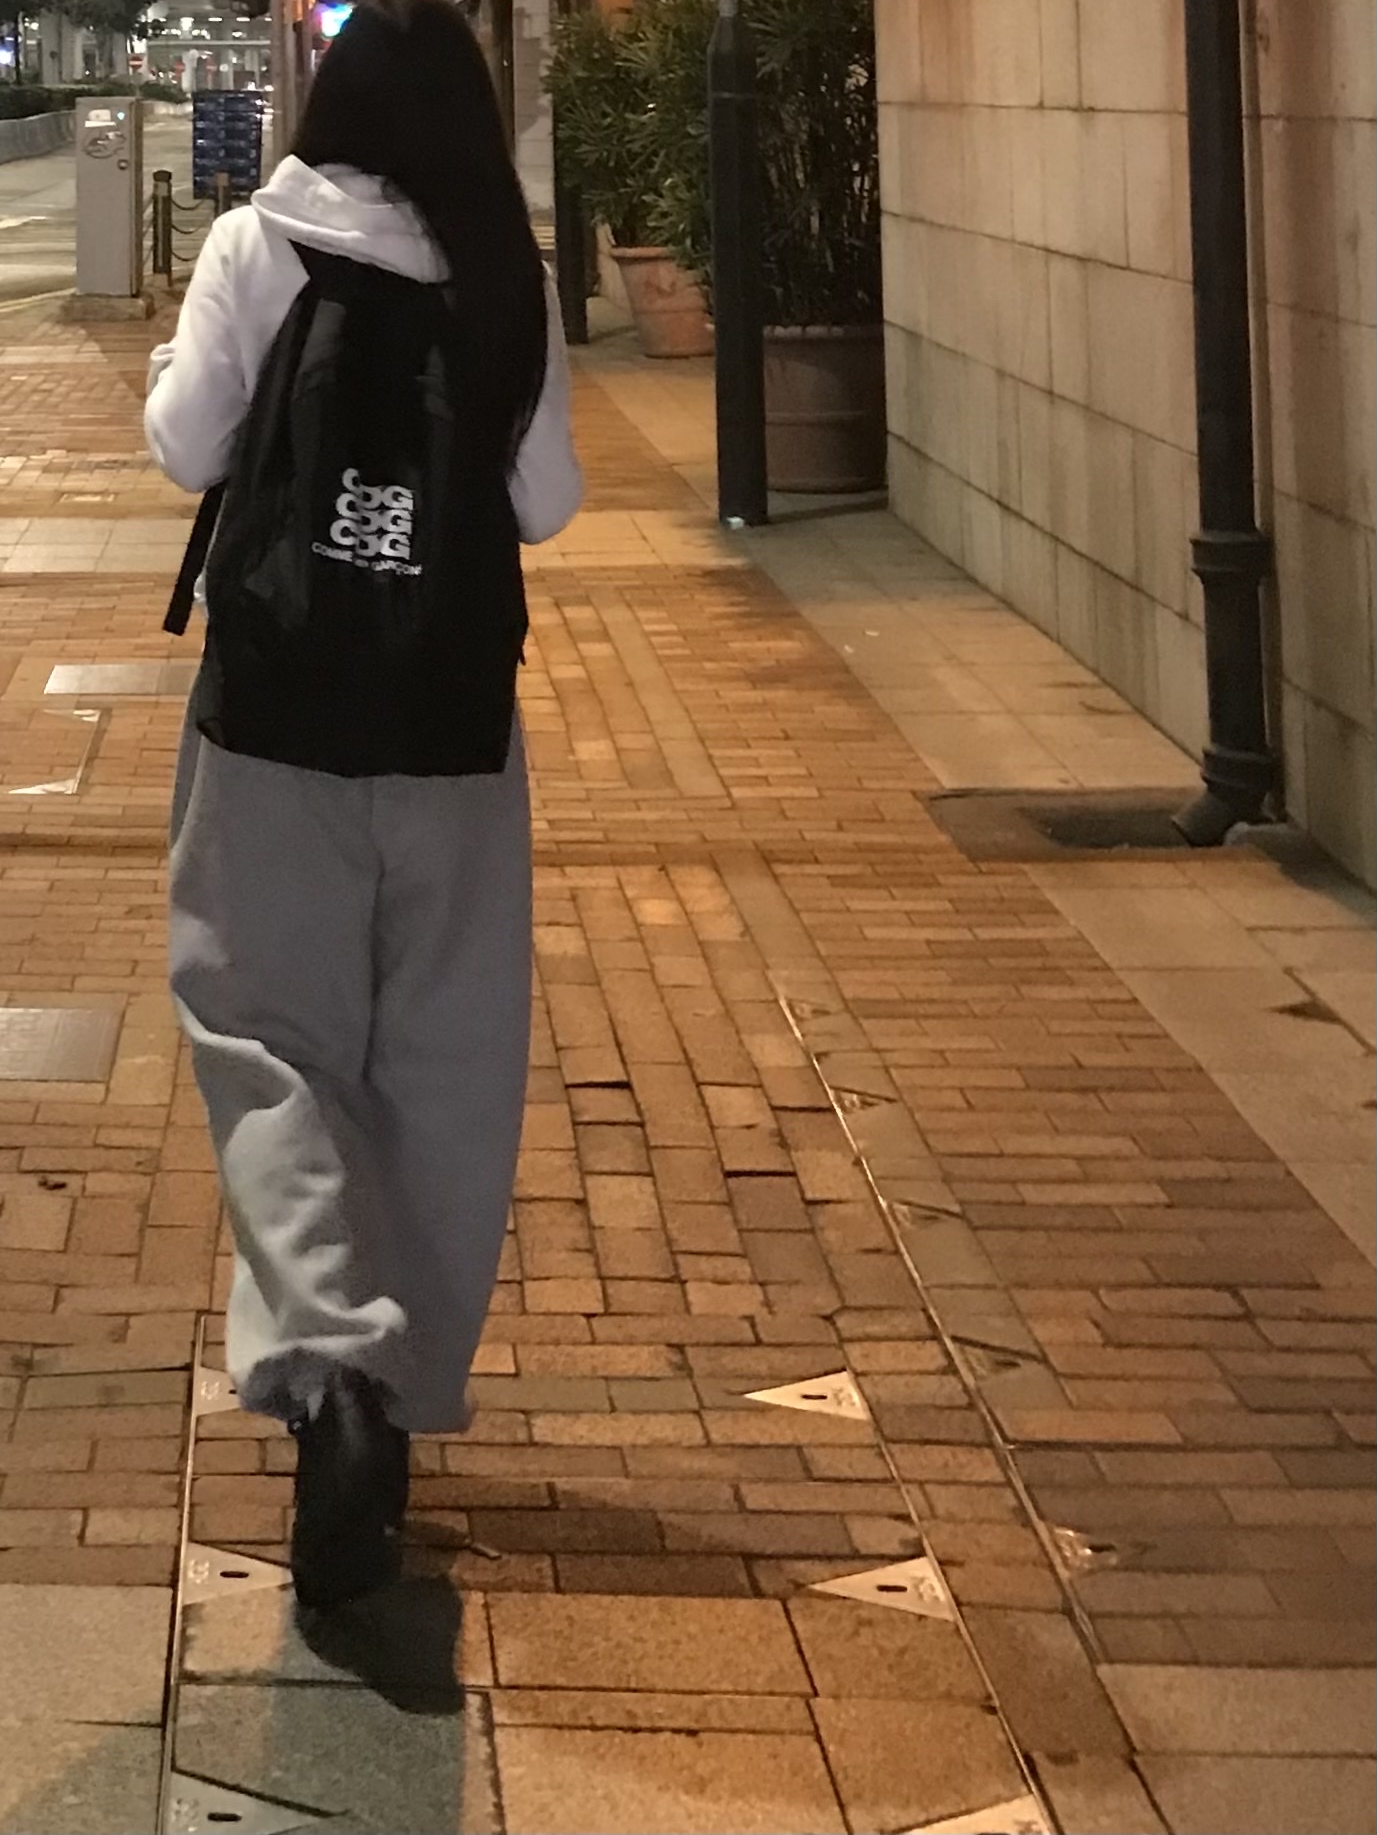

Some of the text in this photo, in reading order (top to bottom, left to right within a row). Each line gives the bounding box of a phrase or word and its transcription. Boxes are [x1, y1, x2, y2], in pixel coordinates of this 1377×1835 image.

[342, 468, 414, 511] CDG
[335, 492, 413, 535] CDG
[330, 518, 411, 560] CDG
